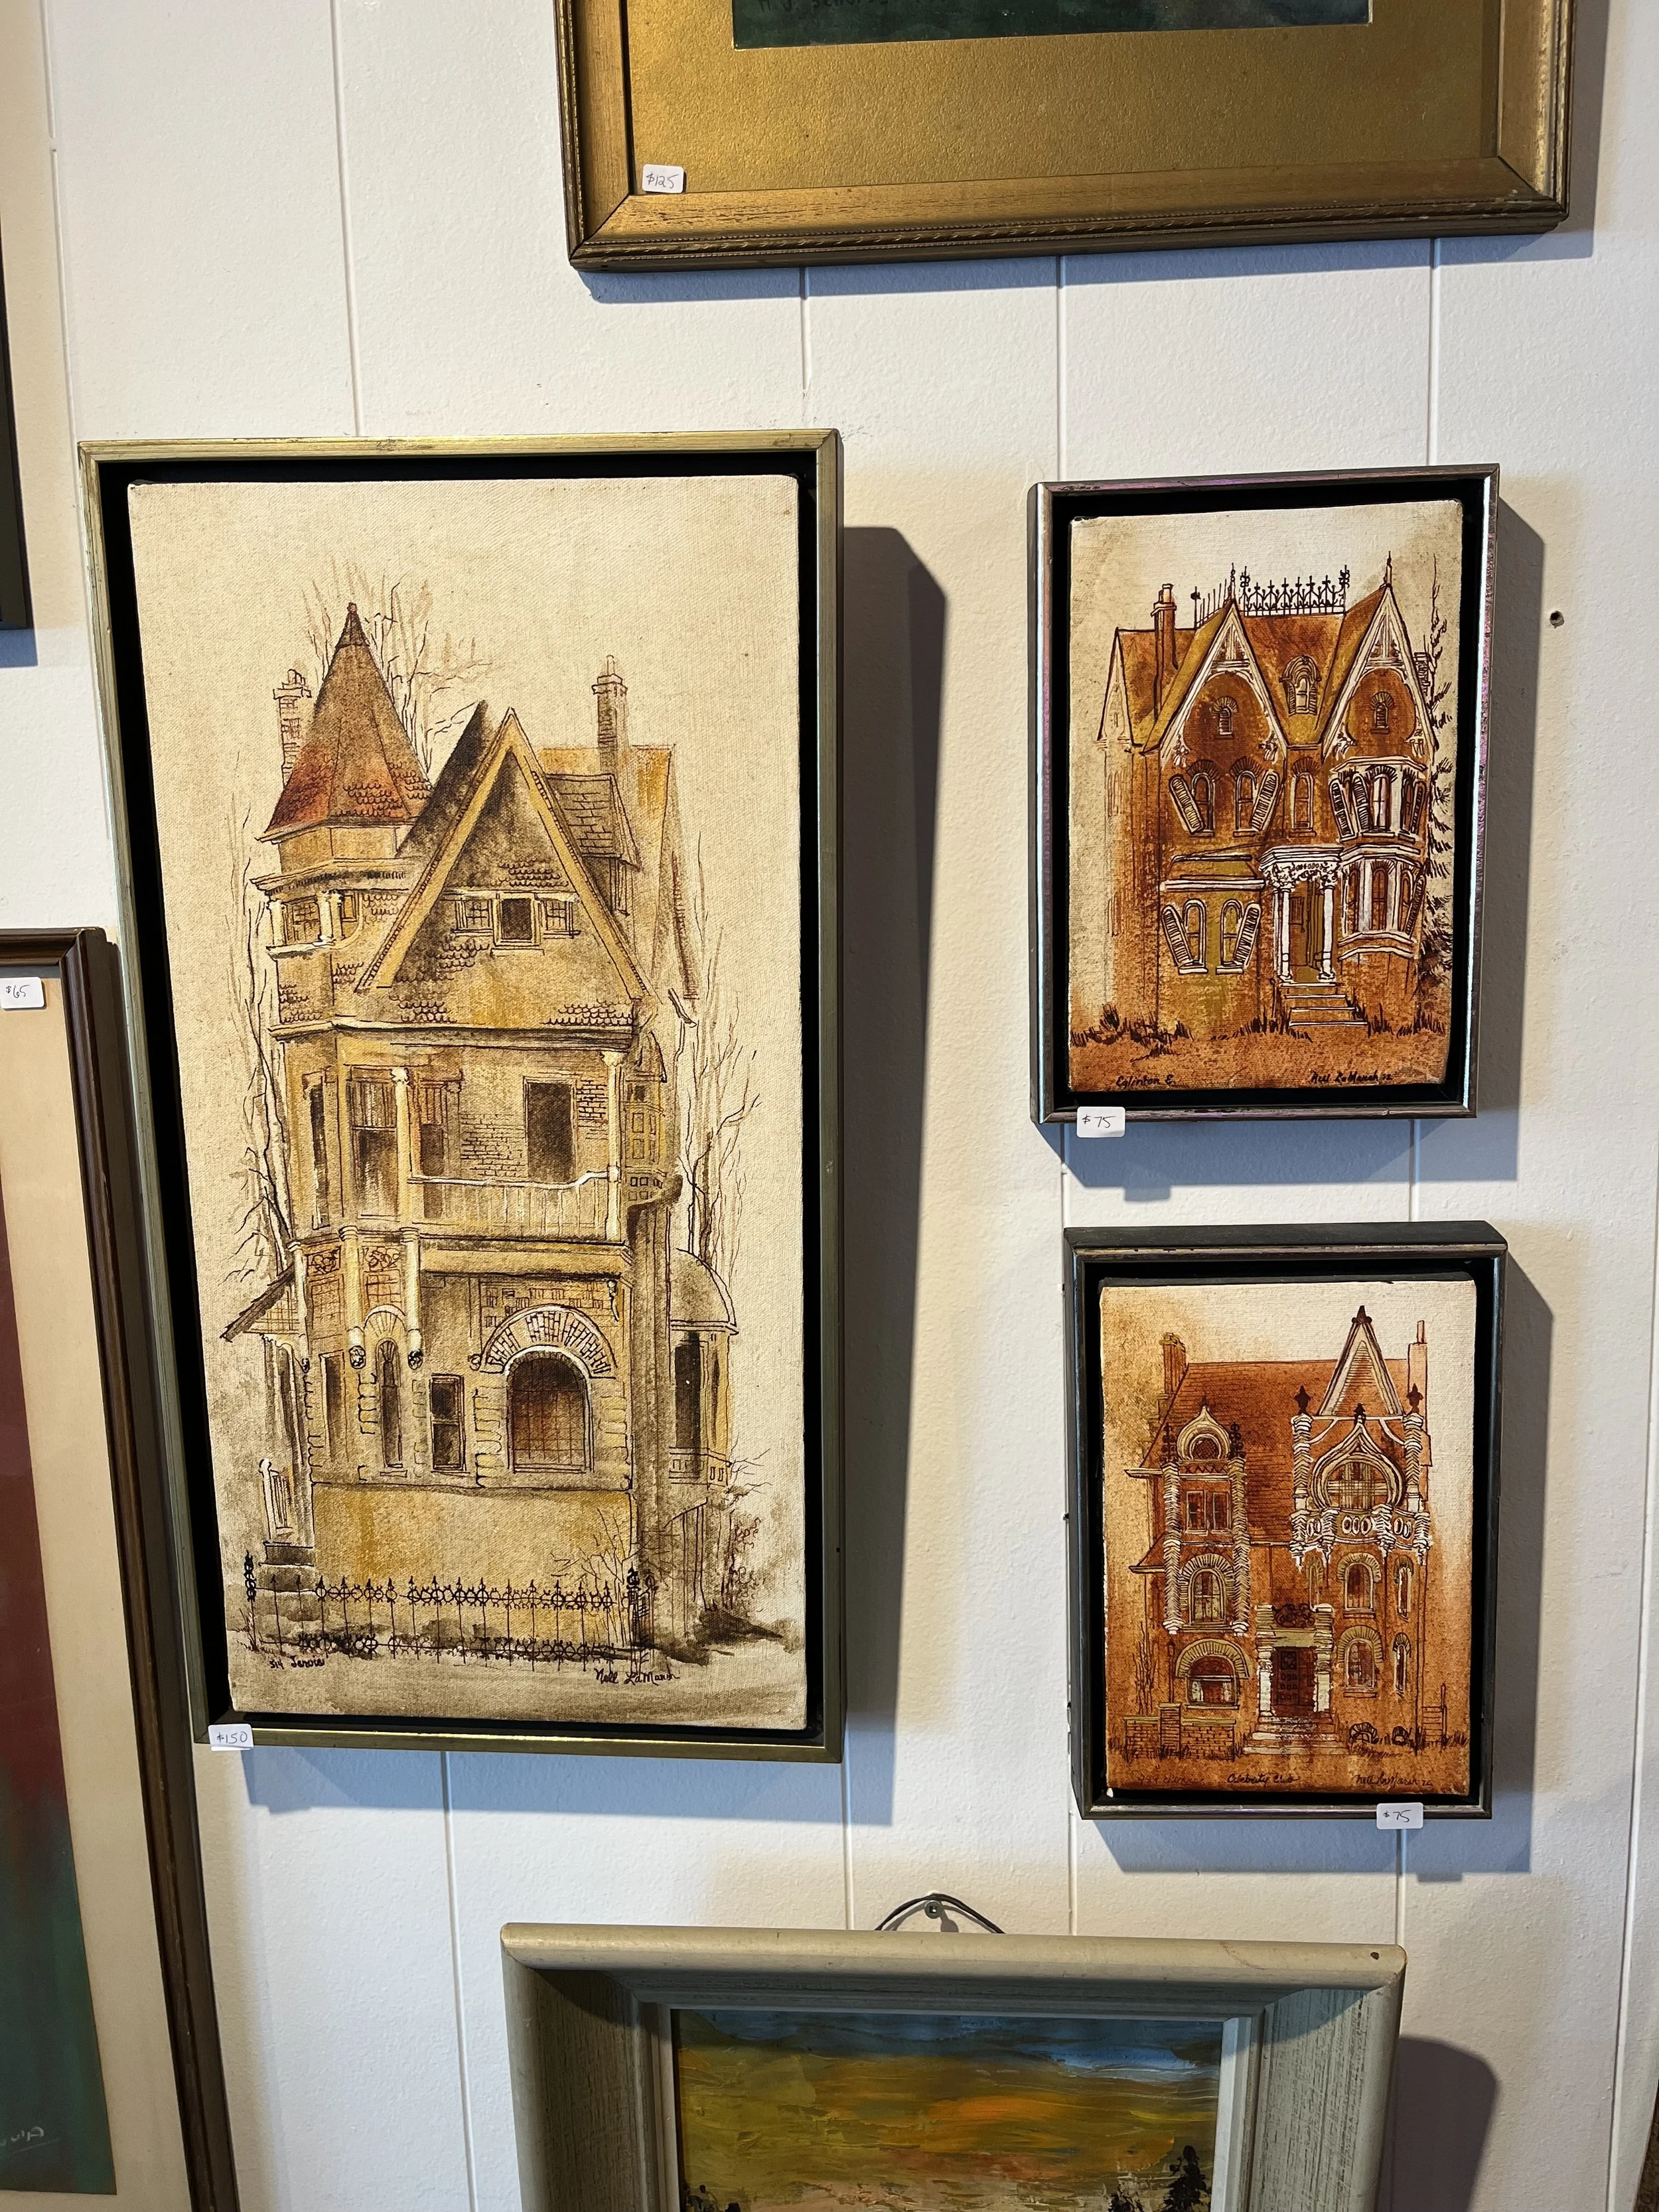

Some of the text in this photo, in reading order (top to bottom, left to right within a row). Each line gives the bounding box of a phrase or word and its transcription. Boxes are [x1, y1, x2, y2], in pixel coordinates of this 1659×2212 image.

[645, 171, 680, 189] $125
[5, 984, 31, 999] $65
[1116, 1074, 1161, 1089] Eglinton
[216, 1731, 248, 1744] $150
